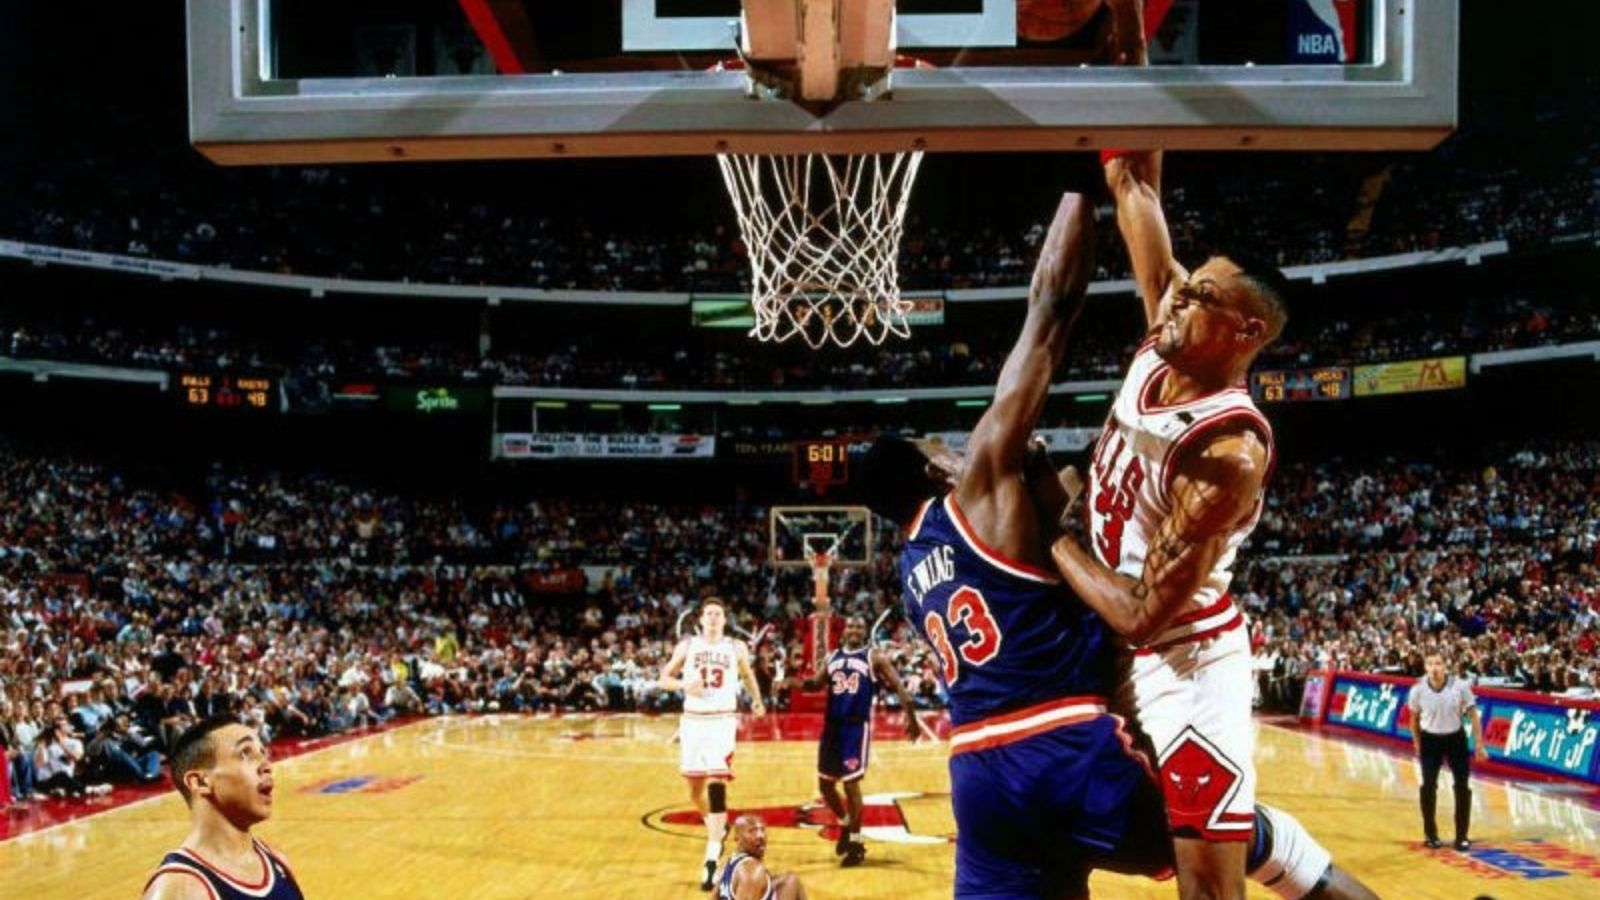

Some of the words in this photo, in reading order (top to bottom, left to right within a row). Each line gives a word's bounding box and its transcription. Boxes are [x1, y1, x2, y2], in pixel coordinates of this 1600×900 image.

[1298, 34, 1336, 54] NBA
[416, 389, 459, 413] Sprite
[808, 444, 844, 462] 6:01
[907, 545, 955, 608] EWING
[925, 585, 1001, 687] 33
[700, 666, 724, 689] 13
[831, 670, 859, 694] 34
